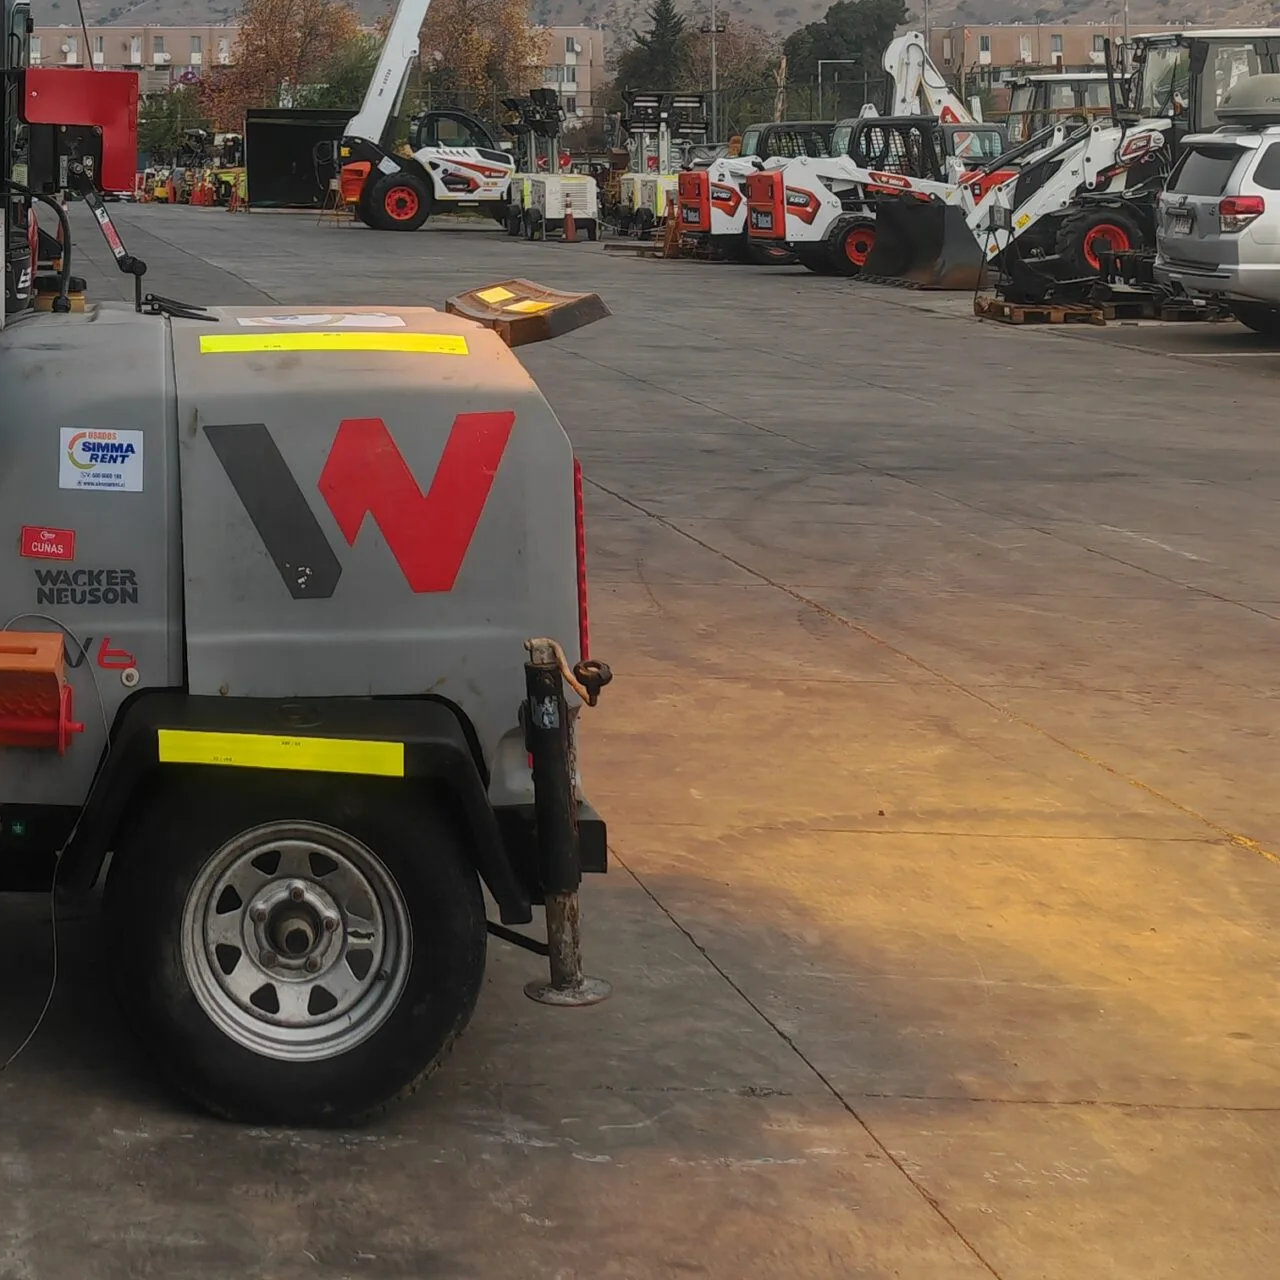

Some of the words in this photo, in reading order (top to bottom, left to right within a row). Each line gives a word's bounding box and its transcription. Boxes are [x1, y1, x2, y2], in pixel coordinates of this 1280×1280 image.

[81, 441, 136, 455] SIMMA
[88, 453, 130, 465] RENT
[34, 569, 139, 587] WACKER
[37, 587, 139, 605] NEUSON
